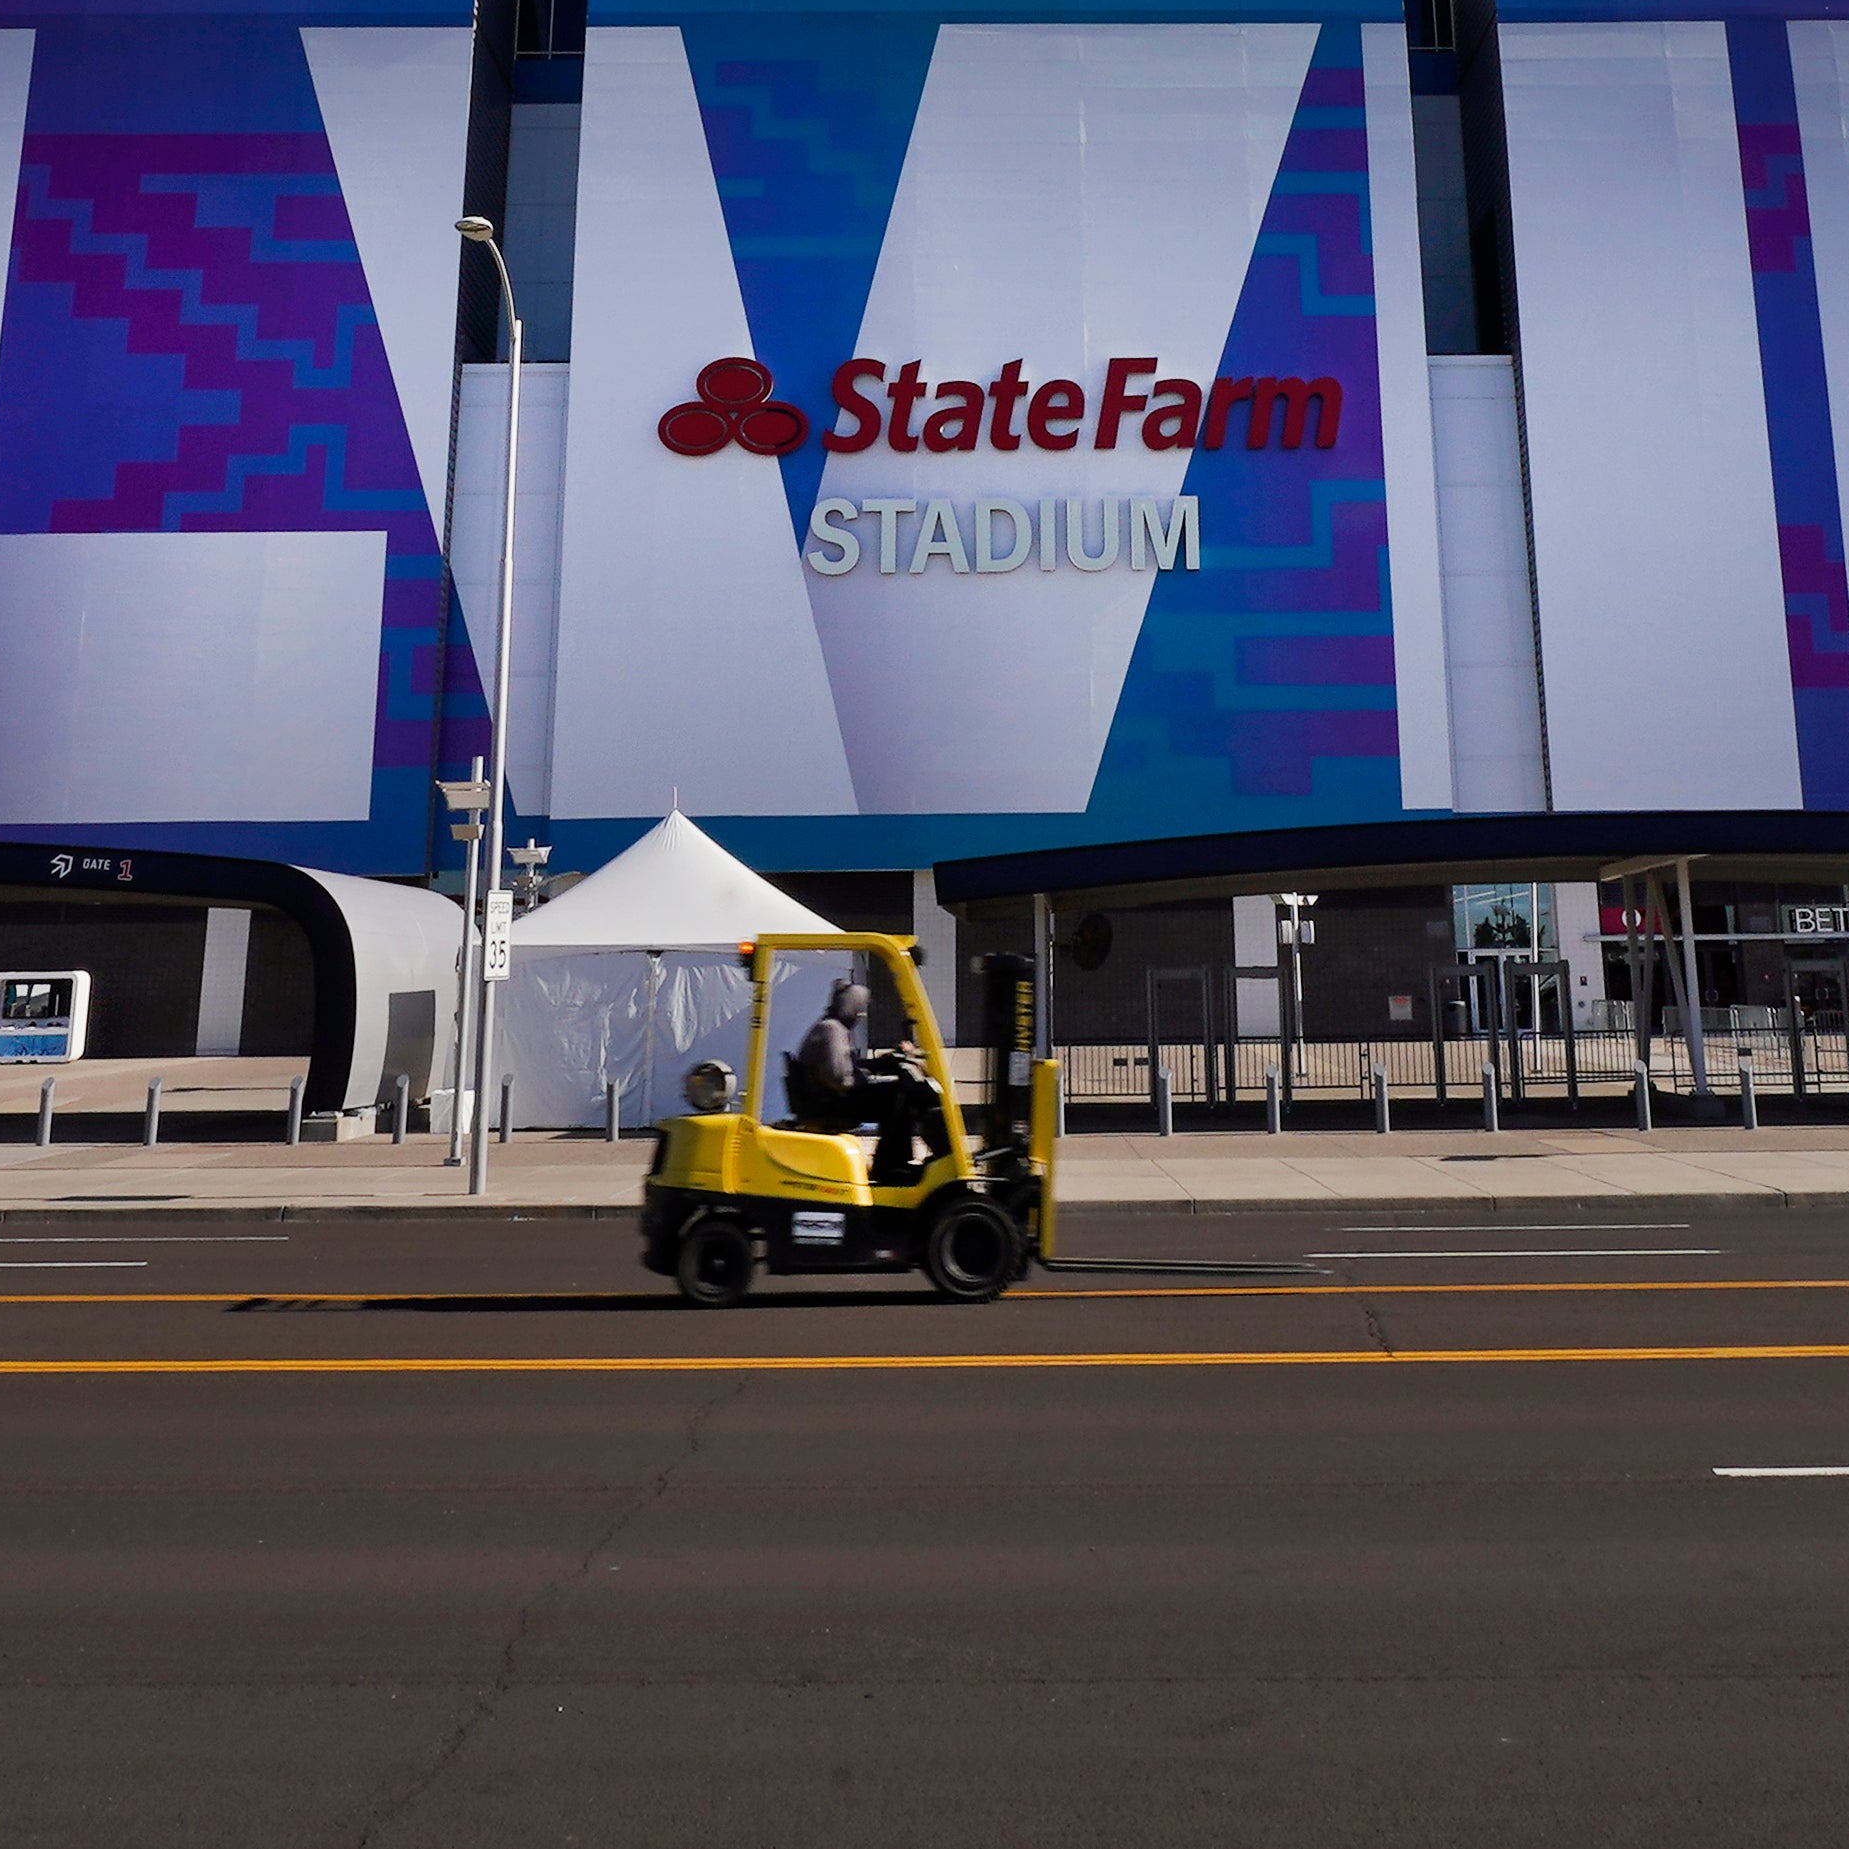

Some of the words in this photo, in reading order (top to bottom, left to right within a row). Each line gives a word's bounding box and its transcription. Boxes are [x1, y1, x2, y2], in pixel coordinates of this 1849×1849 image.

[807, 494, 1201, 576] STADIUM
[82, 858, 111, 871] GATE
[117, 859, 133, 882] 1
[489, 940, 507, 969] 35
